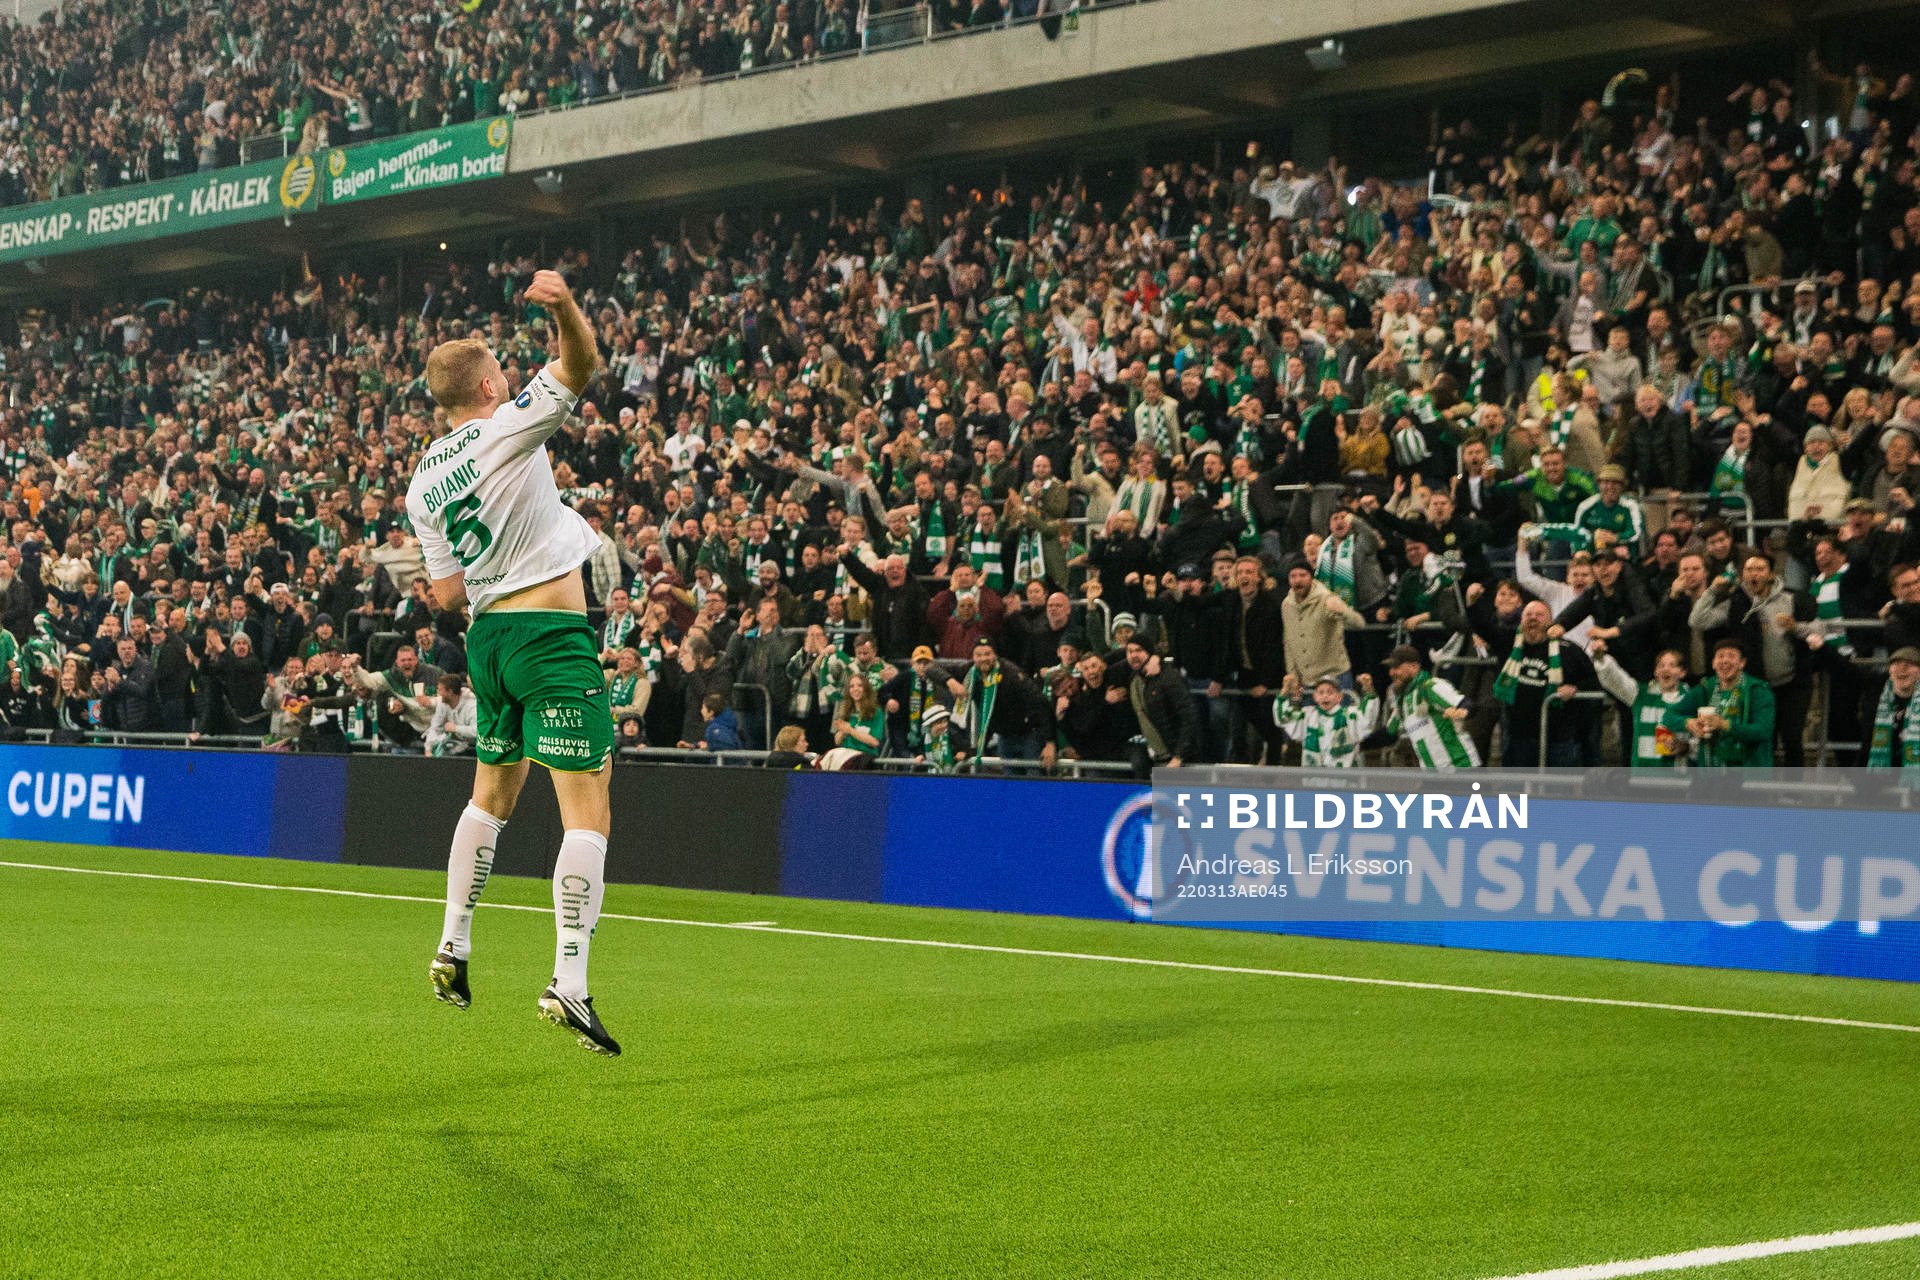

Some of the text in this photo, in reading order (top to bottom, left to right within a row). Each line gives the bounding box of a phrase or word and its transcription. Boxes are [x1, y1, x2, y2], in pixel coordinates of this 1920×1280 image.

[331, 167, 375, 200] Bajen
[0, 175, 272, 250] ENSKAP RESPEKT KÄRLEK
[423, 458, 481, 513] BOJANIC
[444, 493, 493, 567] 6
[537, 745, 591, 757] RENOVA AB
[538, 736, 590, 748] PALLSERVICE
[8, 770, 145, 824] CUPEN
[1233, 827, 1665, 921] SVENSKA
